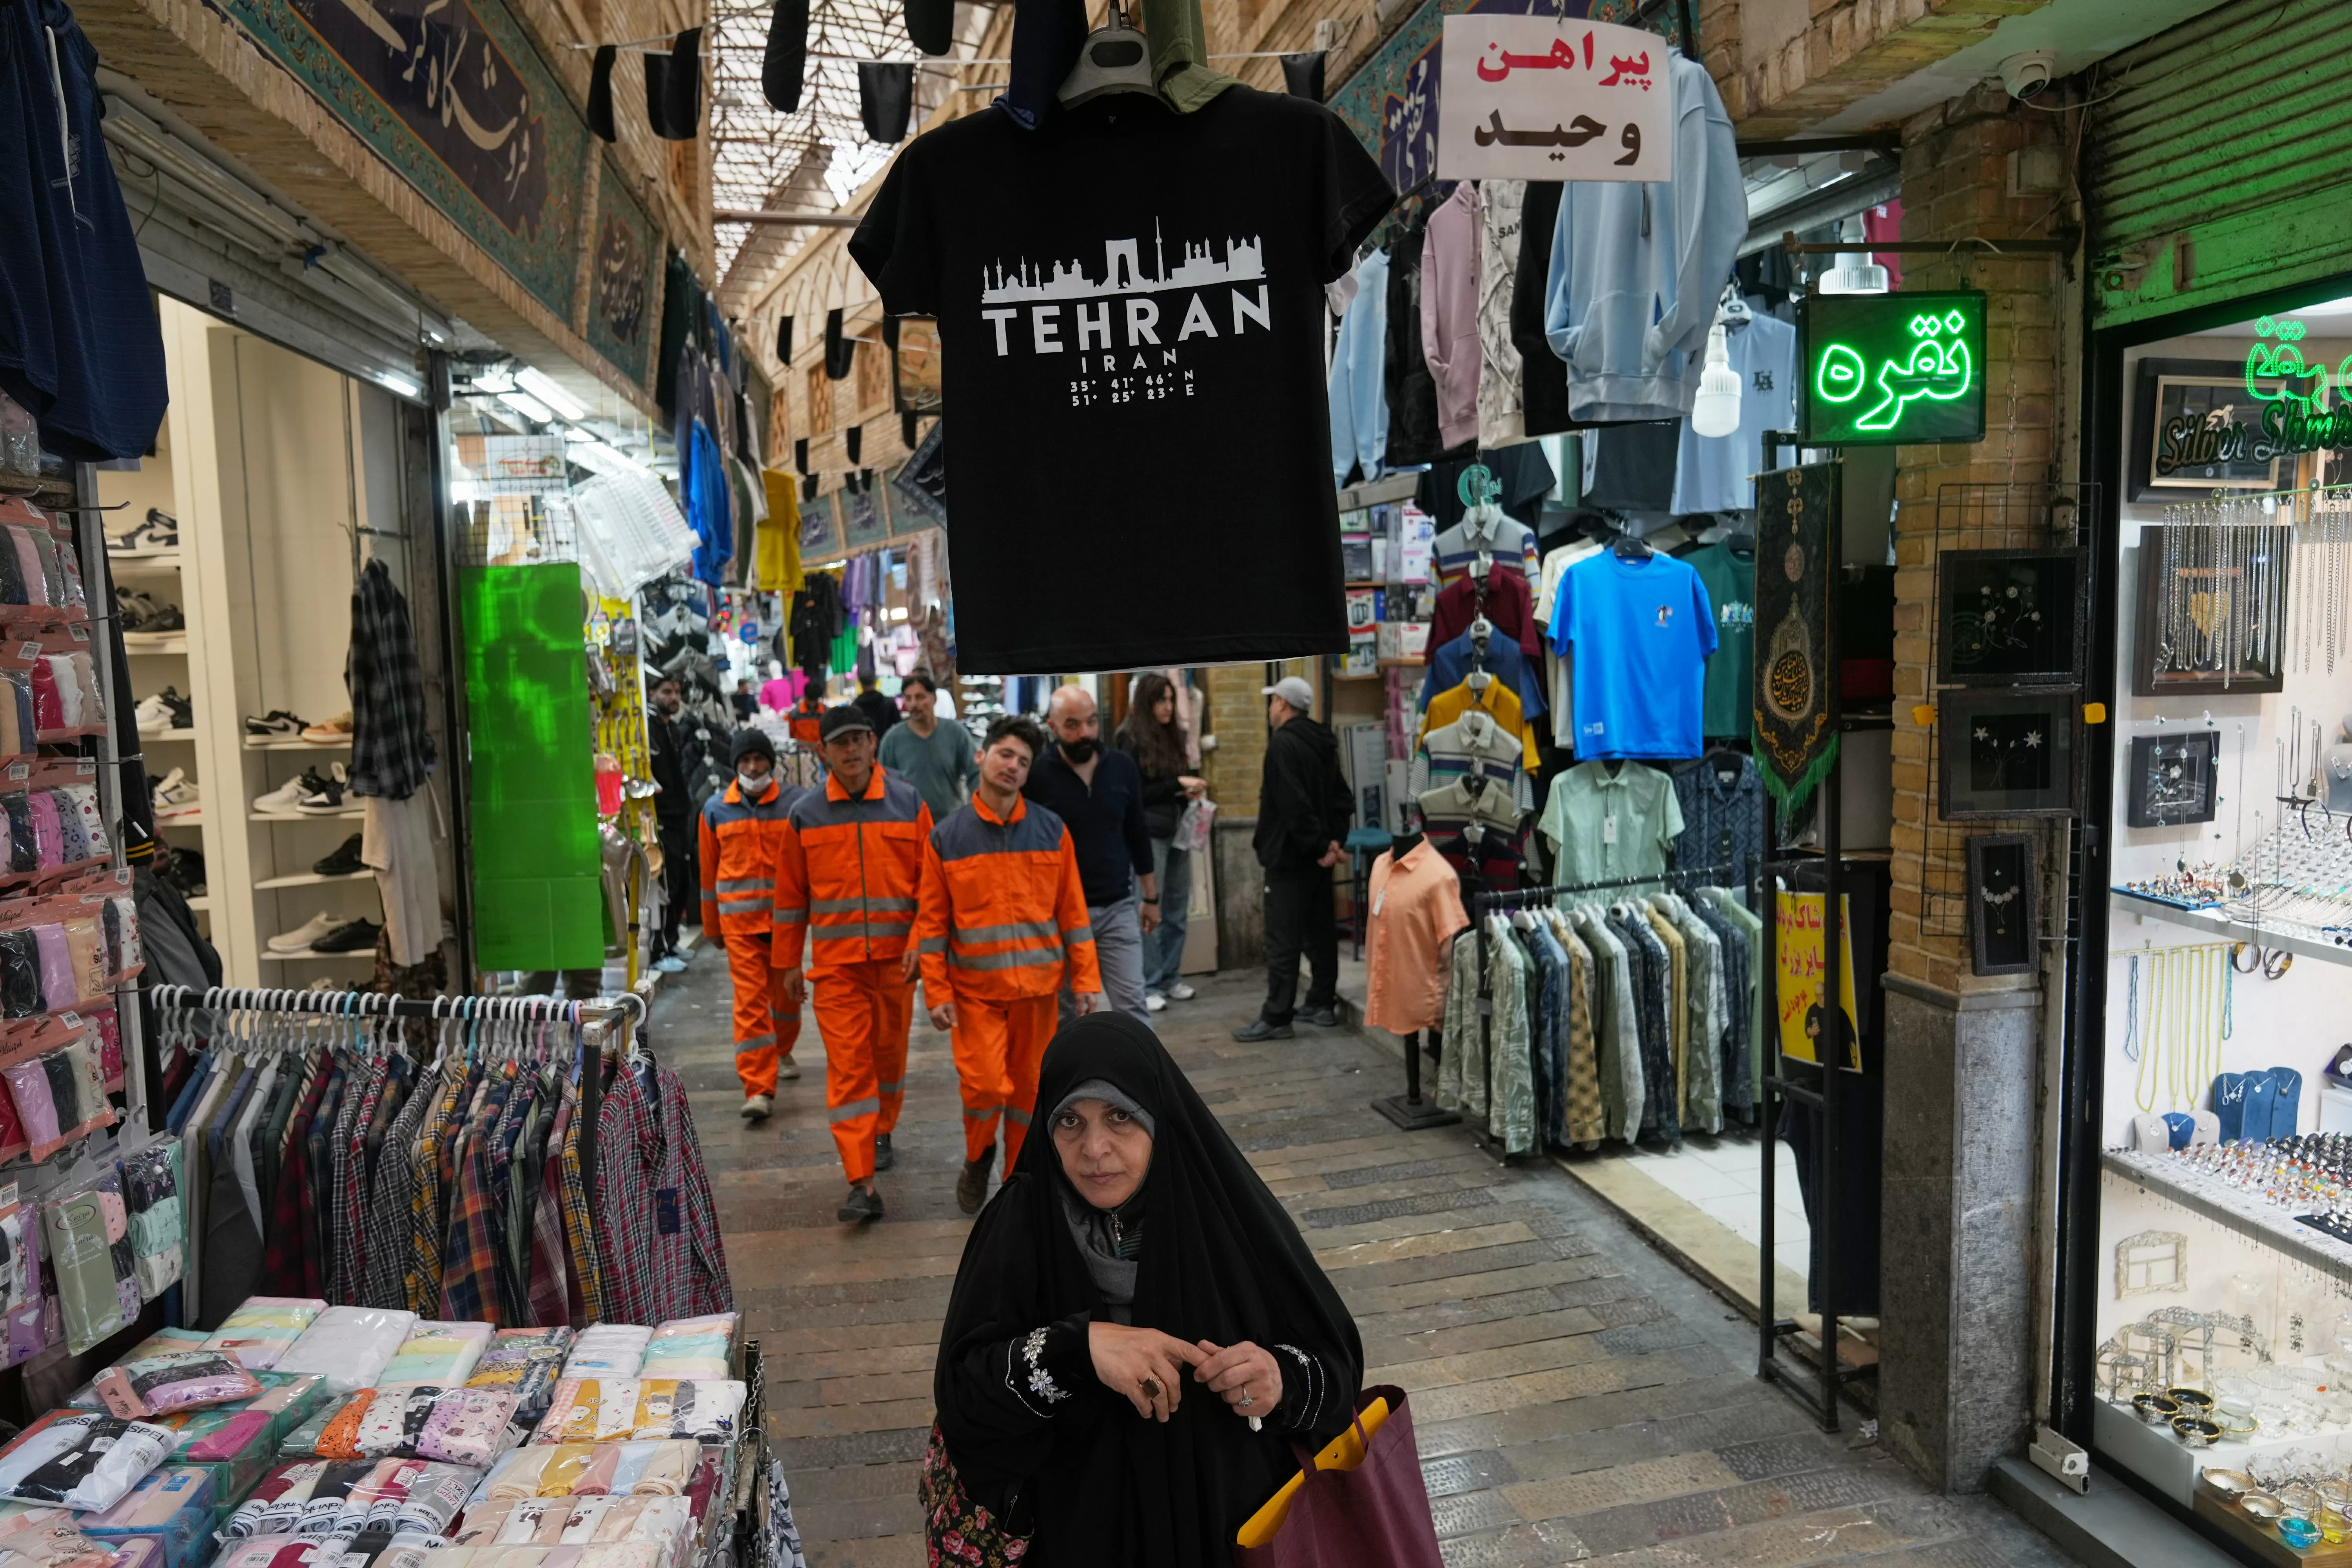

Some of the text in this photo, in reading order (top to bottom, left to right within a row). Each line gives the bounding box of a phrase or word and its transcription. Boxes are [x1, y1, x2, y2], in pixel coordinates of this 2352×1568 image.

[1477, 30, 1652, 92] پیراهن
[1474, 109, 1641, 166] وحید
[982, 285, 1270, 356] TEHRAN
[1082, 348, 1176, 373] IRAN
[1185, 370, 1193, 381] N
[1817, 309, 1973, 432] نقره
[1186, 384, 1194, 396] E
[2156, 413, 2249, 475] Silver
[61, 1211, 90, 1223] Kaira
[67, 1235, 93, 1249] Kaira
[437, 1489, 458, 1506] Lupo
[454, 1484, 465, 1497] 3XL
[404, 1552, 421, 1562] MISSPEL
